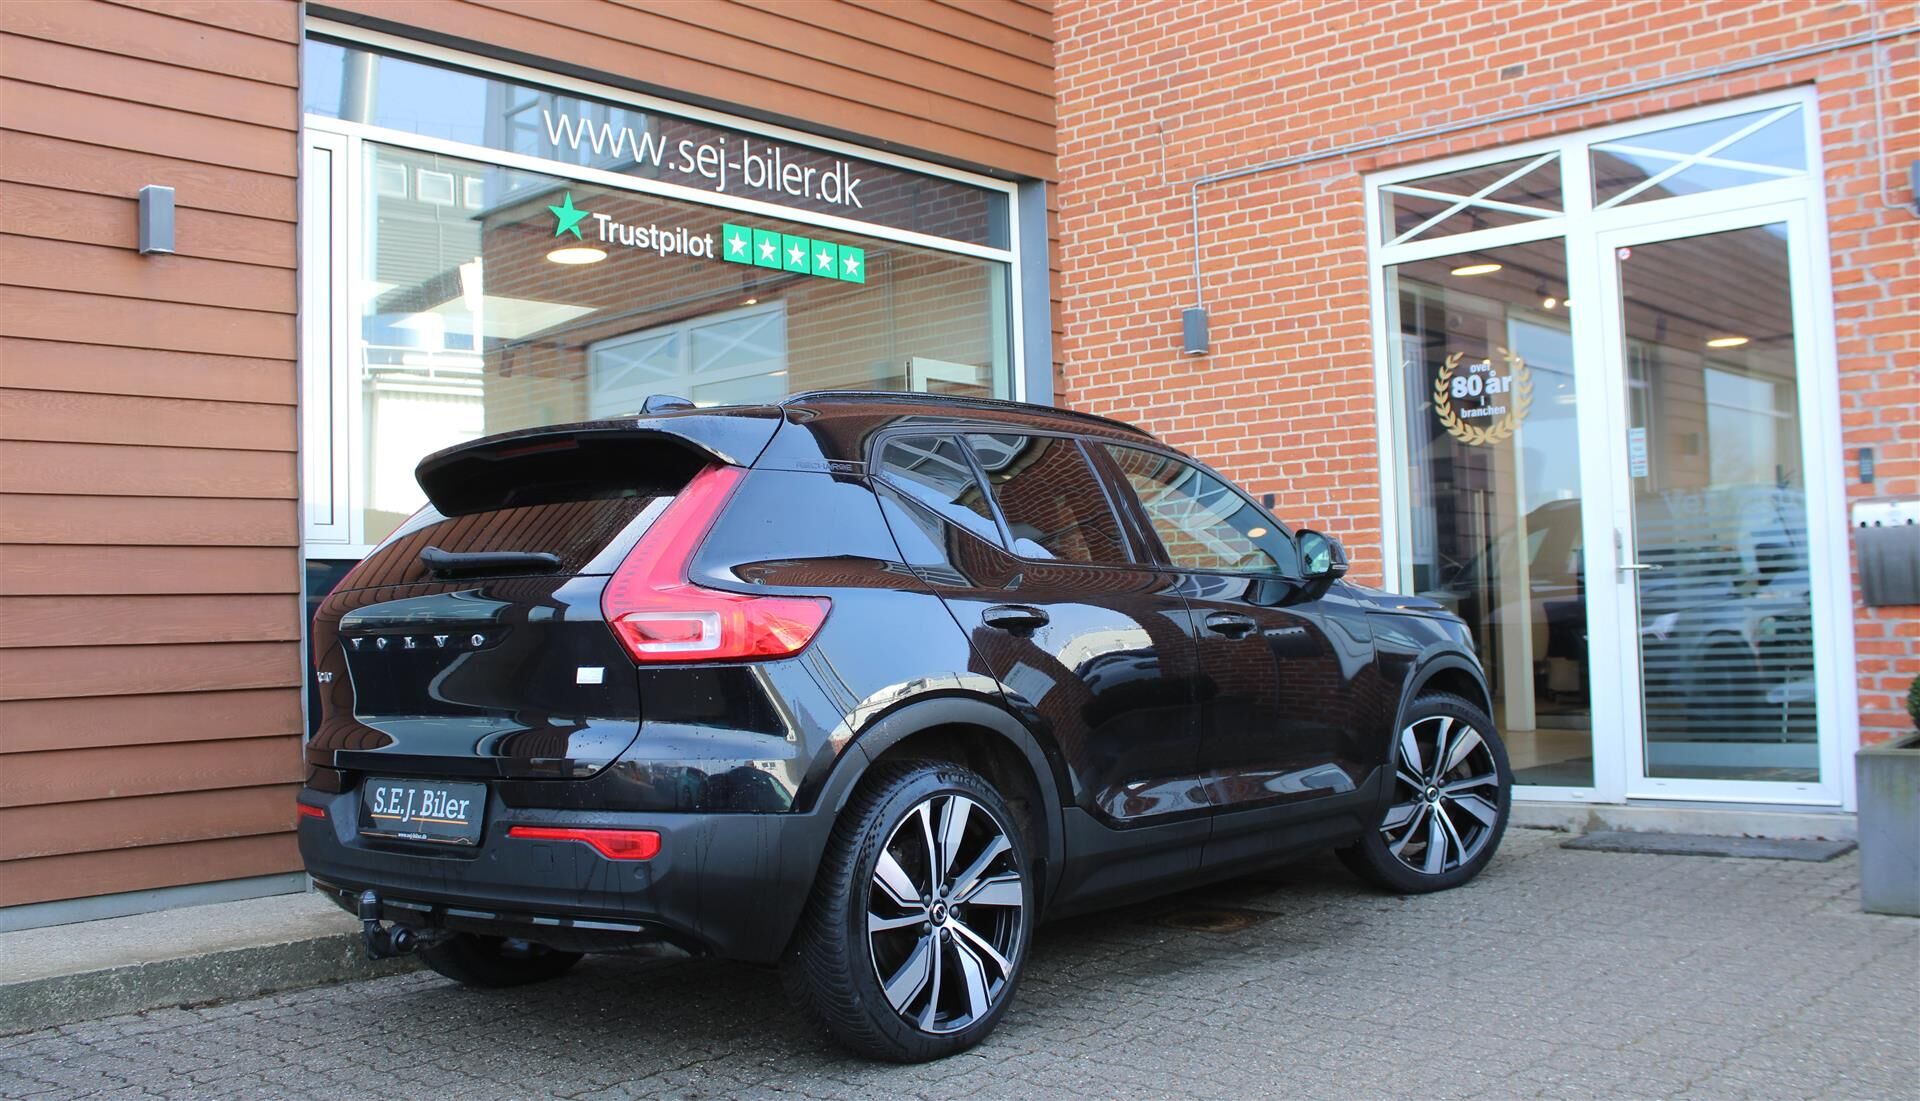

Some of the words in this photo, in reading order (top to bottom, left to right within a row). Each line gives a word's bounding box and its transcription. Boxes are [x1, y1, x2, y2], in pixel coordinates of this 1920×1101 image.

[543, 109, 864, 208] www.sej-biler.dk
[592, 212, 715, 259] Trustpilot
[1470, 363, 1491, 373] over
[1452, 374, 1483, 398] 80
[1485, 370, 1512, 394] år
[1480, 395, 1485, 406] i
[1461, 406, 1506, 418] branchen
[351, 633, 485, 649] VOLVO
[373, 786, 416, 822] S.E.J.
[420, 789, 469, 819] Biler
